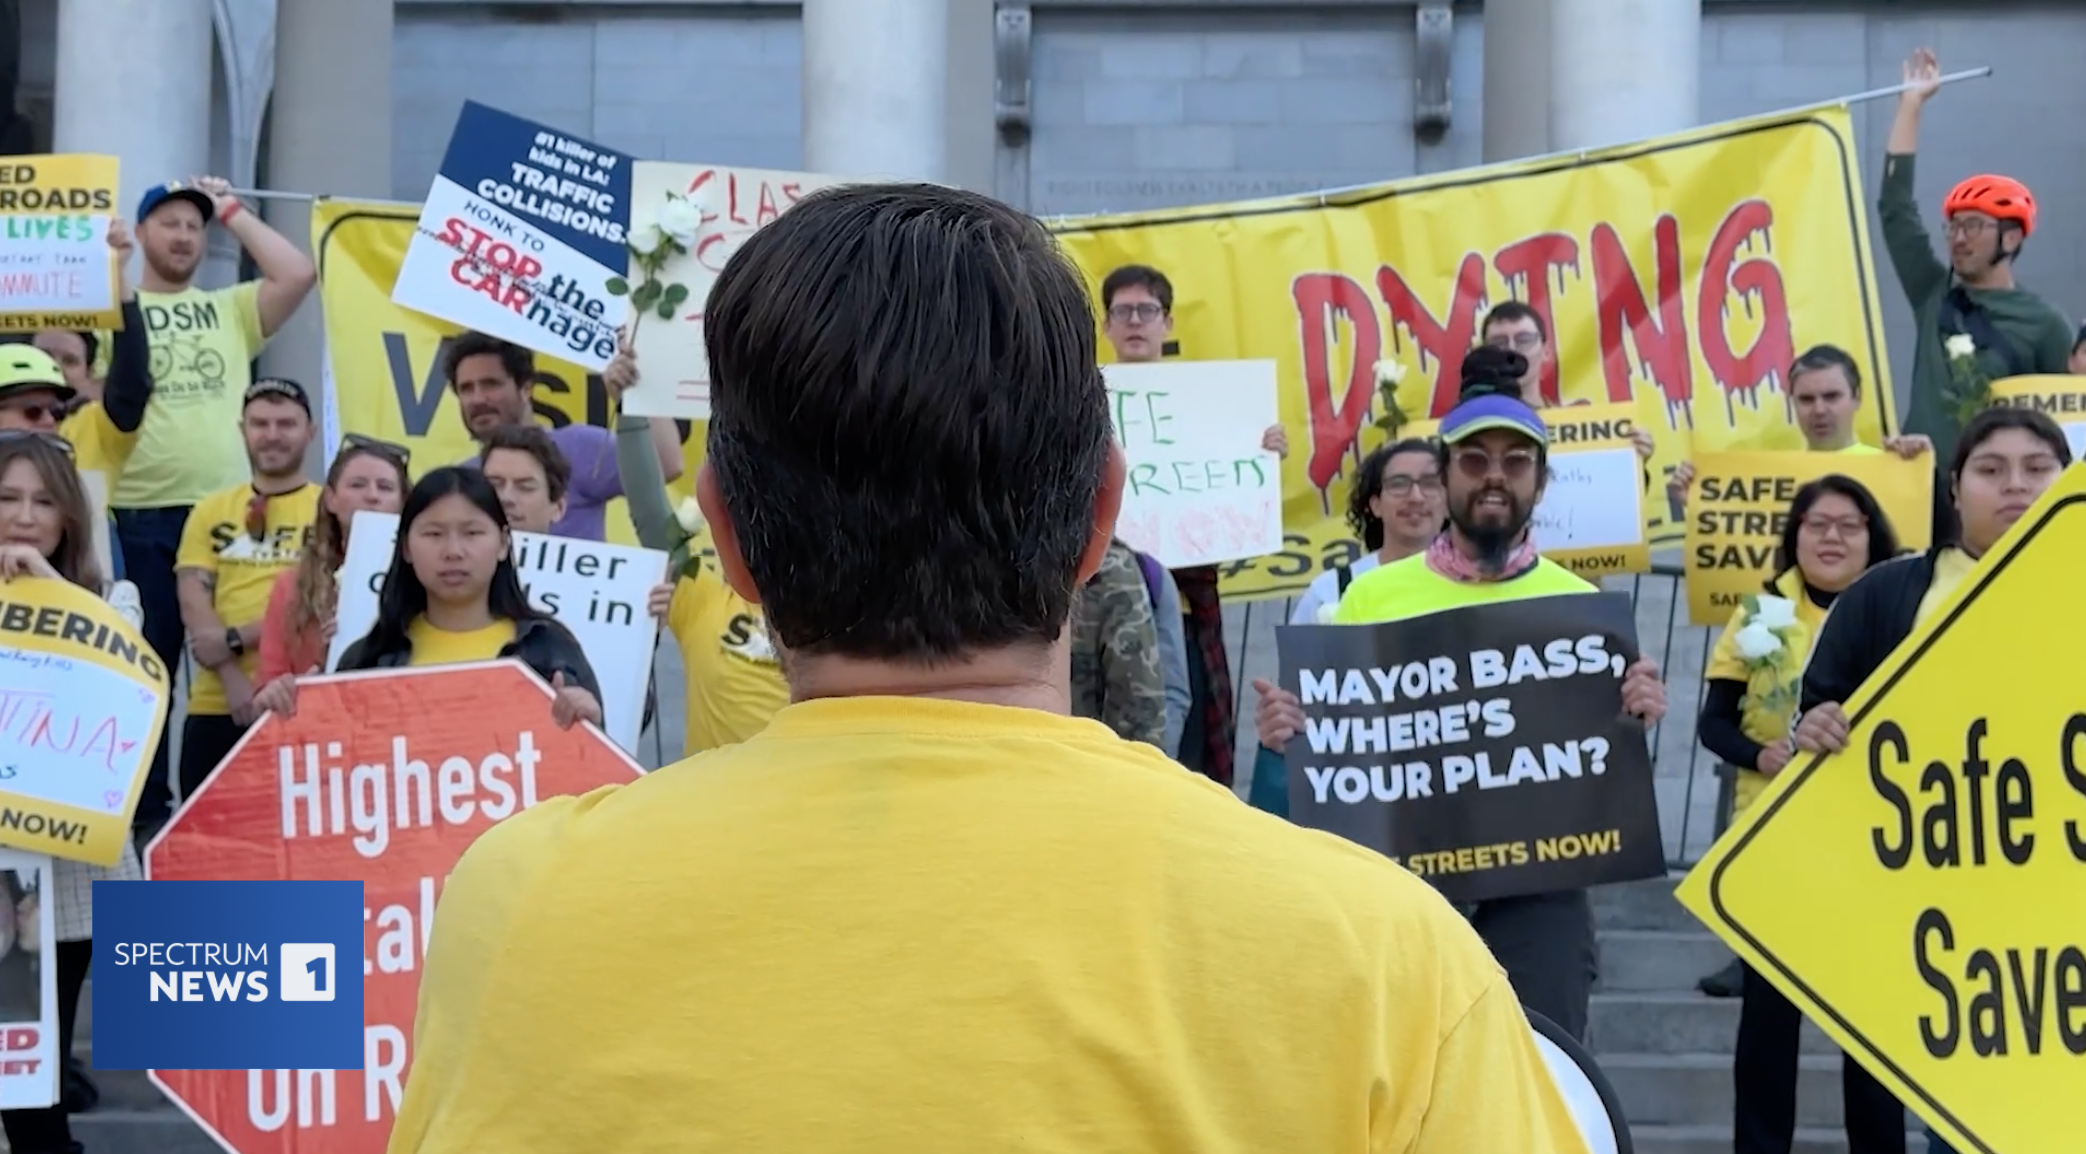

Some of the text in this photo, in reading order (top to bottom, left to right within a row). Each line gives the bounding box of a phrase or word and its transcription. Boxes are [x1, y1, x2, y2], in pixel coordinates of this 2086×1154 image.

[528, 146, 562, 170] kids
[563, 158, 581, 175] in
[555, 137, 597, 162] killer
[597, 154, 617, 170] of
[476, 178, 627, 245] COLLISIONS.
[511, 162, 615, 214] TRAFFIC
[7, 215, 94, 242] LIVES
[464, 200, 545, 252] HONK TO
[436, 218, 605, 321] STOP the
[44, 313, 98, 328] NOW!
[1291, 199, 1798, 505] DYING
[1699, 476, 1796, 502] SAFE
[517, 536, 628, 580] iller
[587, 590, 633, 625] in
[0, 600, 163, 682] BERING
[1299, 634, 1627, 706] MAYOR BASS,
[278, 731, 541, 858] Highest
[1304, 736, 1611, 804] YOUR PLAN?
[1867, 717, 2035, 871] Safe
[0, 806, 89, 846] NOW!
[1408, 829, 1621, 877] STREETS NOW!
[1913, 907, 2086, 1060] Save
